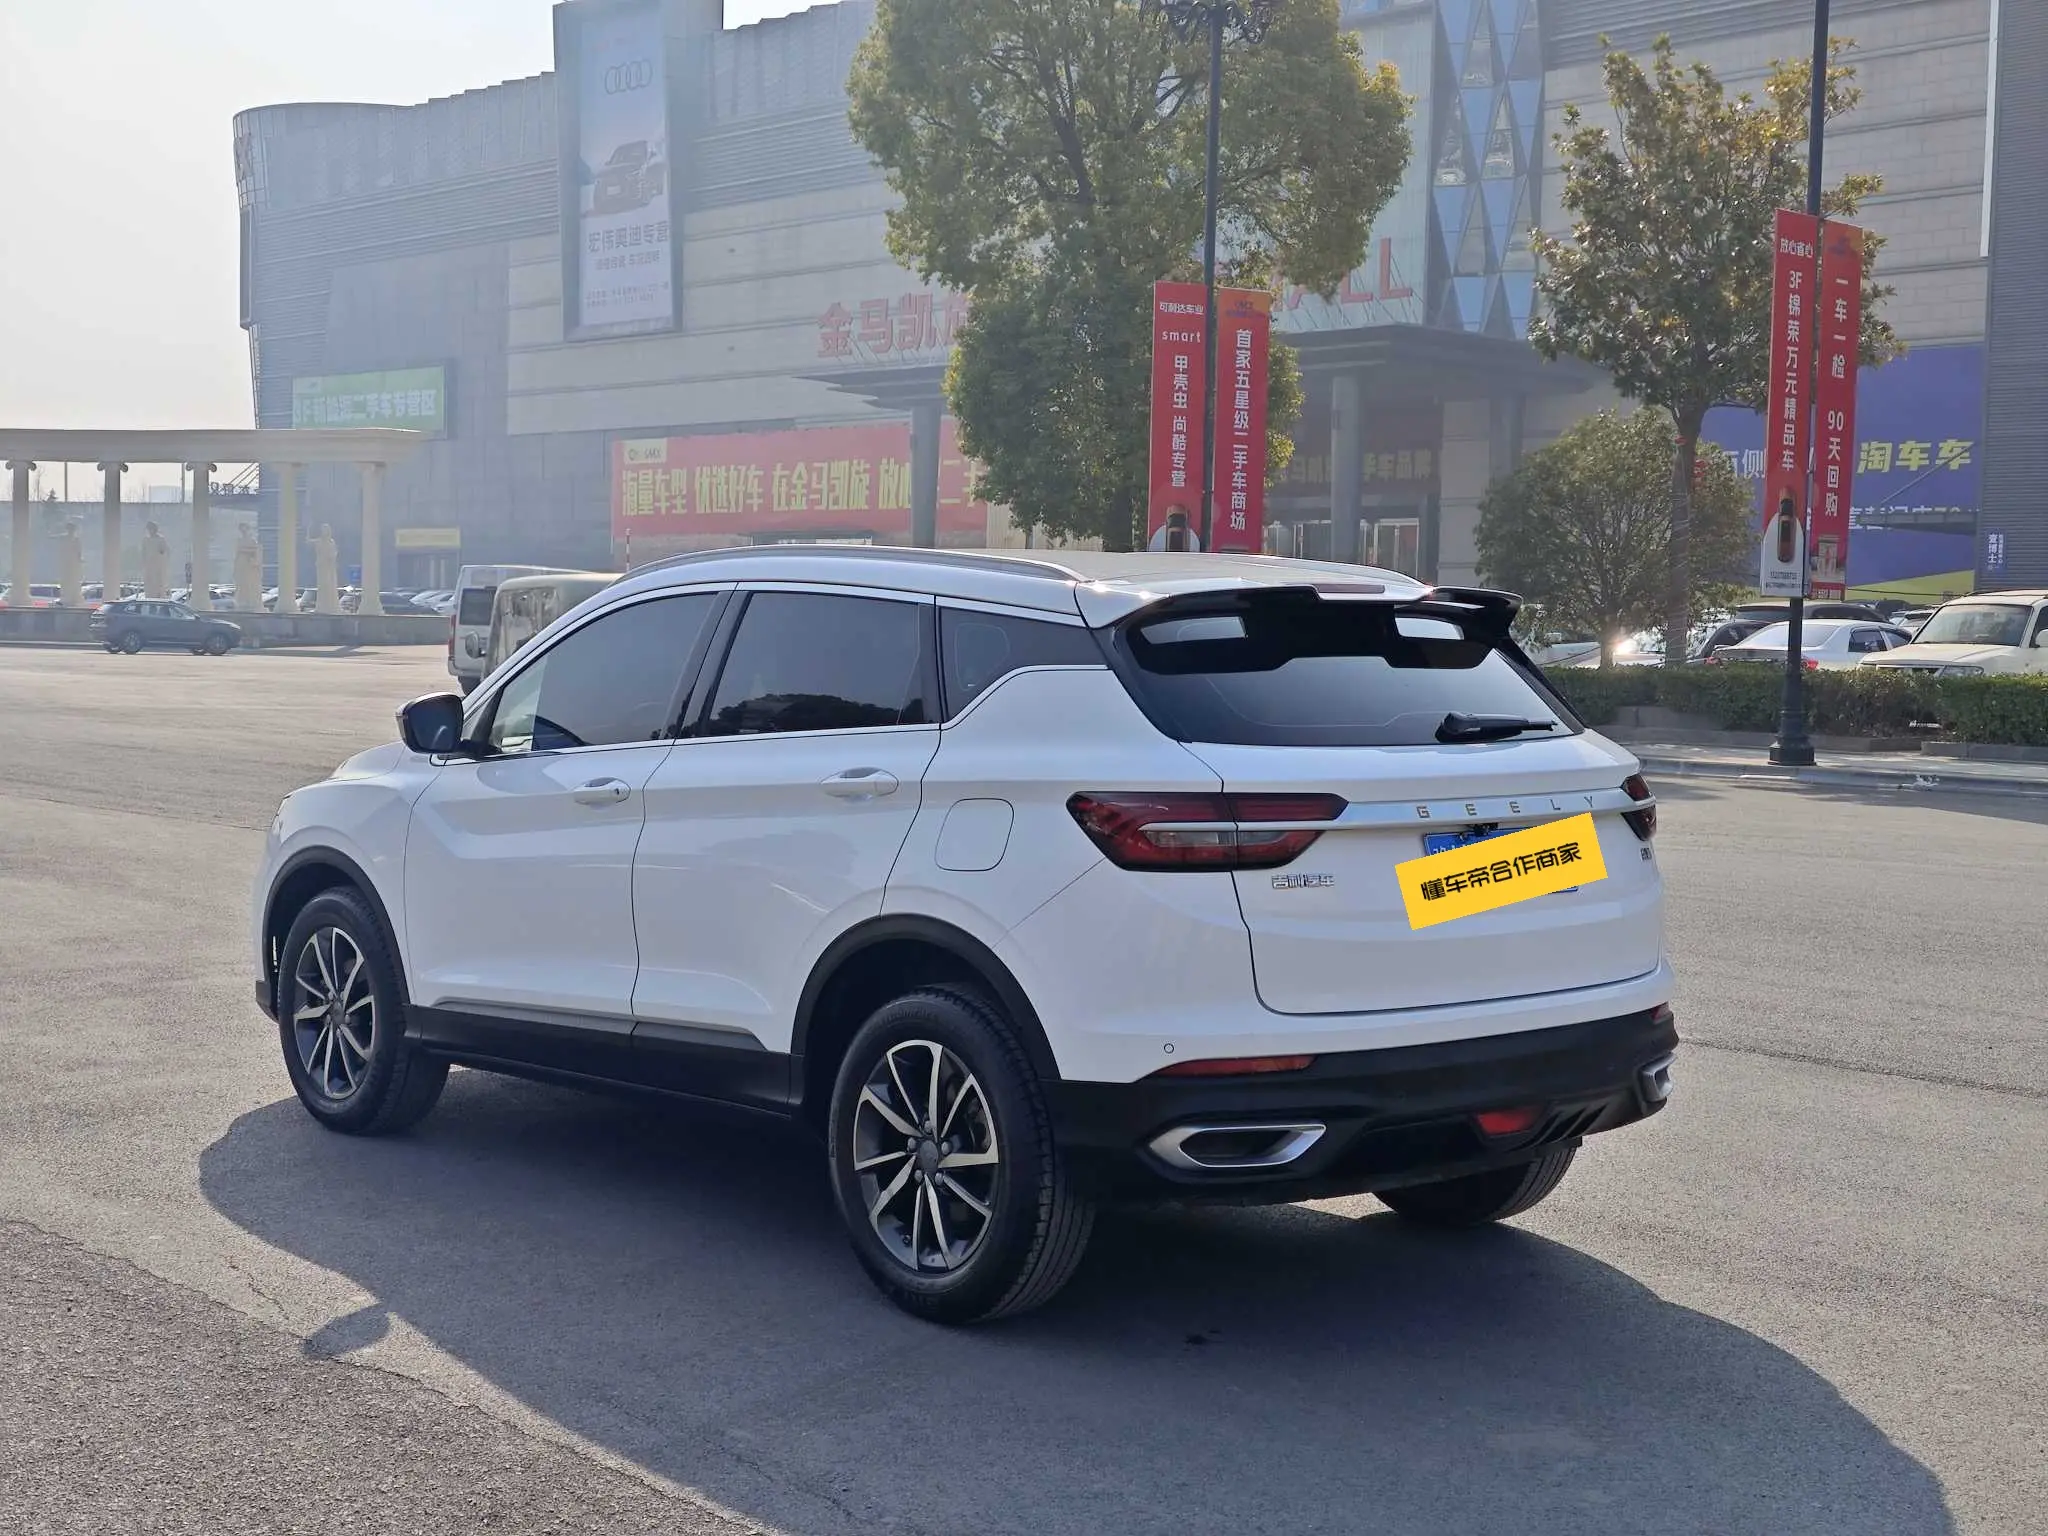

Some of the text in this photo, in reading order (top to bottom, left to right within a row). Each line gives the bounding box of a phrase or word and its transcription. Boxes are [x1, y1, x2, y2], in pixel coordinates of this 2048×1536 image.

[1780, 238, 1813, 258] 放心省心
[1162, 329, 1201, 343] smart
[1171, 355, 1188, 487] 甲壳虫 尚酷专营
[1824, 279, 1849, 517] 一车一检 90天回购
[1230, 328, 1252, 531] 首家五星级二手车商场
[1855, 438, 1974, 474] 淘车车
[622, 469, 687, 516] 海量车型
[694, 463, 764, 513] 优选好车
[772, 458, 870, 512] 在金马凯旋
[1416, 795, 1595, 819] GEELY
